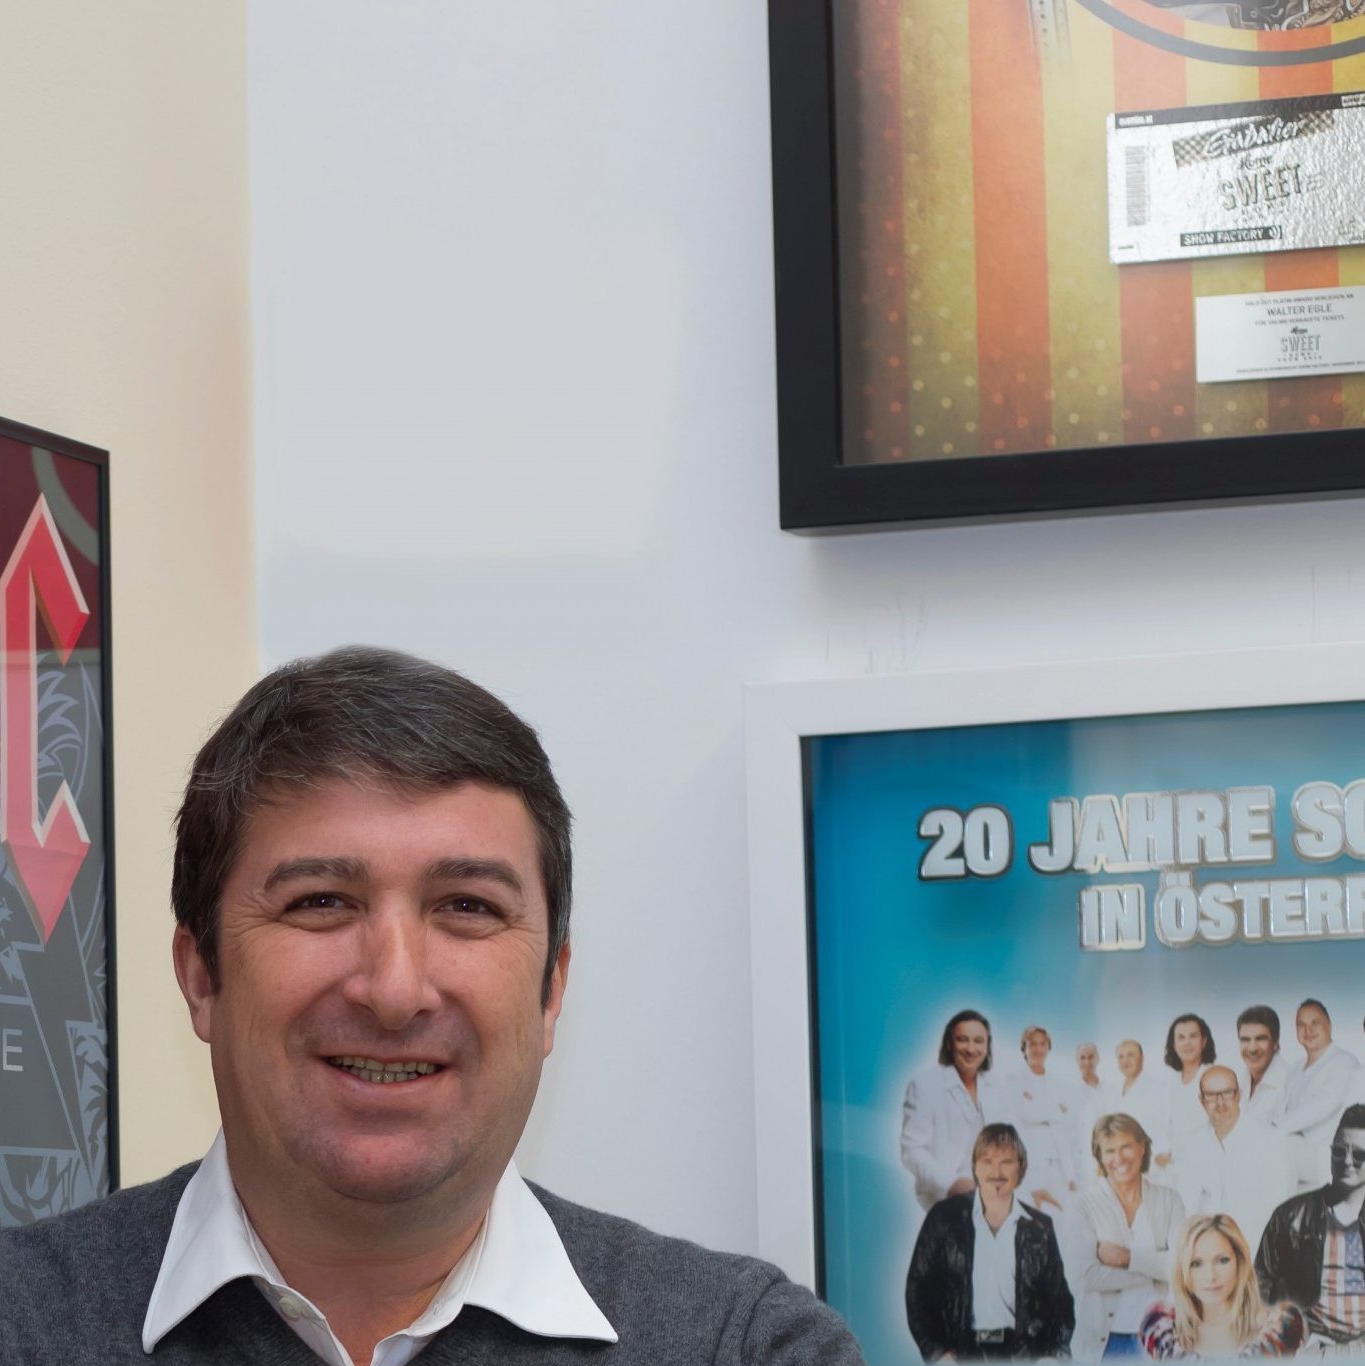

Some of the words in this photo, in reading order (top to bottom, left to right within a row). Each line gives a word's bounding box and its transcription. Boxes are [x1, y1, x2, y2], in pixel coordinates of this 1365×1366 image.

[1219, 164, 1301, 211] SWEET
[1184, 232, 1214, 246] SHOW
[1217, 228, 1264, 244] FACTORY
[1266, 305, 1305, 316] WALTER
[1281, 334, 1321, 353] SWEET
[919, 802, 1015, 881] 20
[1028, 784, 1277, 875] JAHRE
[1079, 884, 1146, 950] IN
